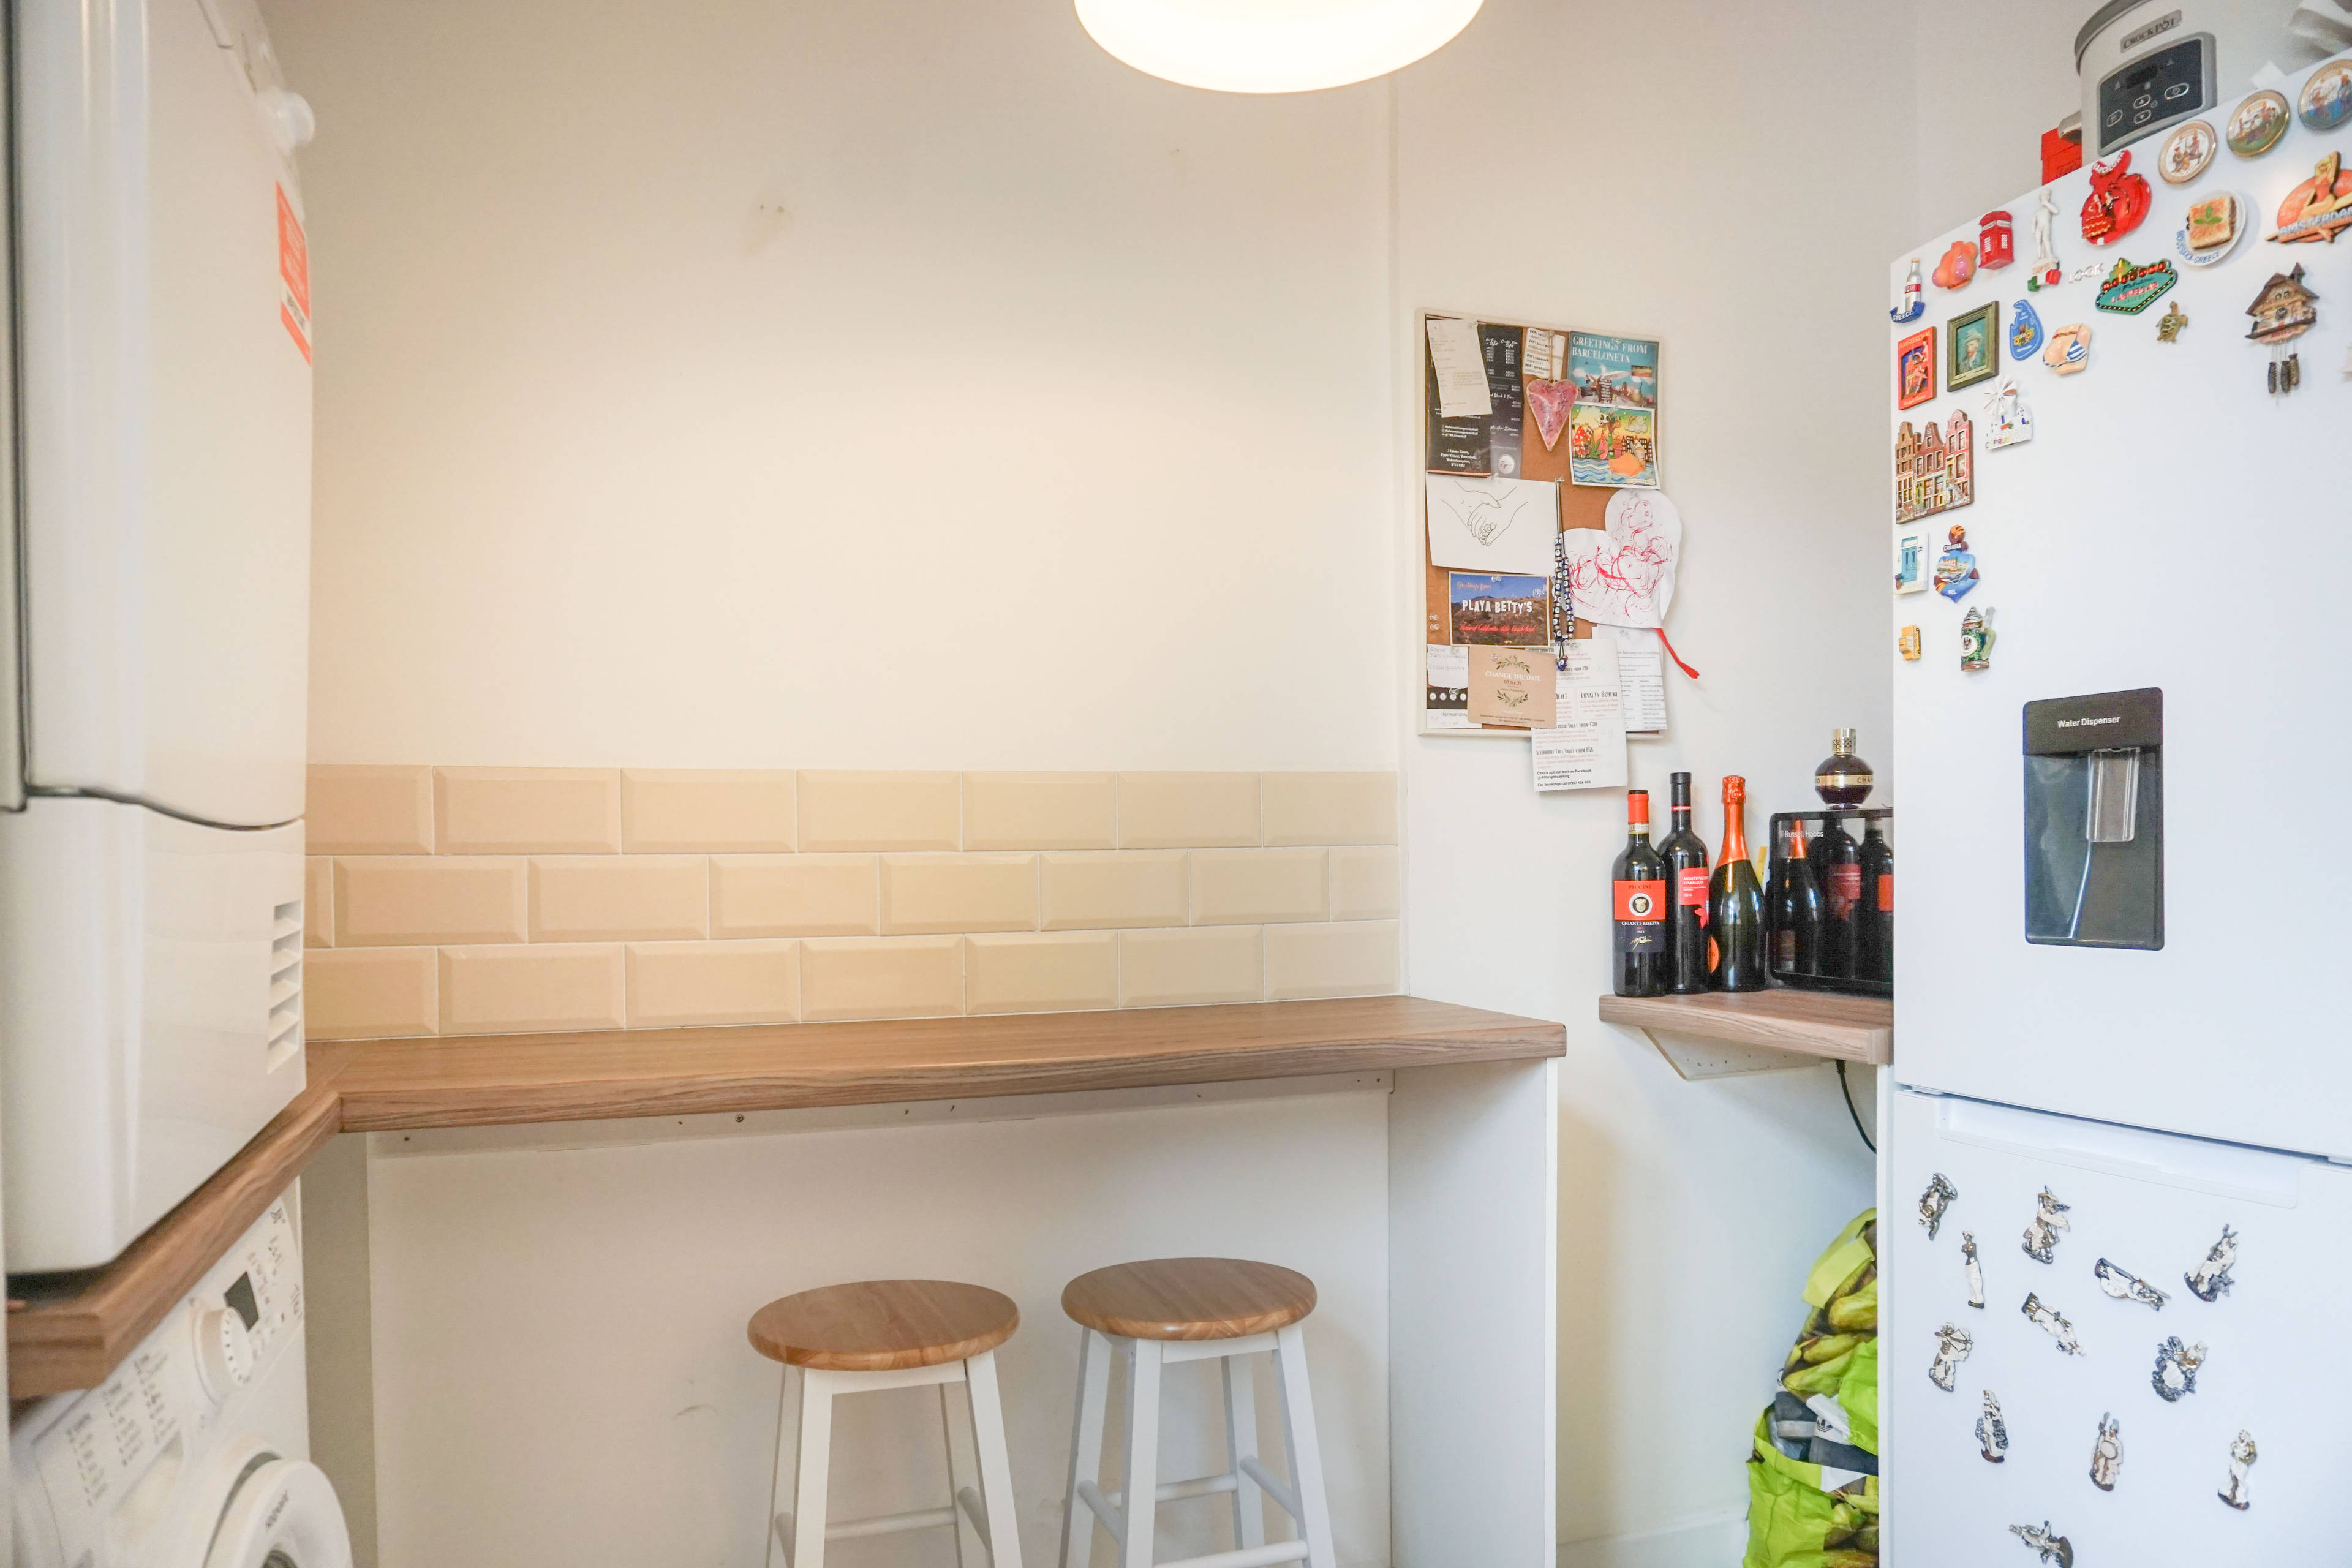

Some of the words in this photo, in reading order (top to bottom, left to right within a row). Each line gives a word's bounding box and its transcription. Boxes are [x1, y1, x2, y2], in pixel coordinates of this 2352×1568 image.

[2068, 262, 2105, 284] LOGIK
[1892, 309, 1913, 322] GREECE
[1572, 335, 1618, 351] GREETINGS
[1622, 342, 1648, 355] FROM
[1572, 346, 1630, 363] BARCELONETA
[1462, 599, 1491, 612] PLAYA
[1494, 600, 1532, 614] BETTY'S
[1485, 670, 1512, 679] CHANGE
[2057, 719, 2081, 728] Water
[2081, 716, 2120, 726] Dispenser
